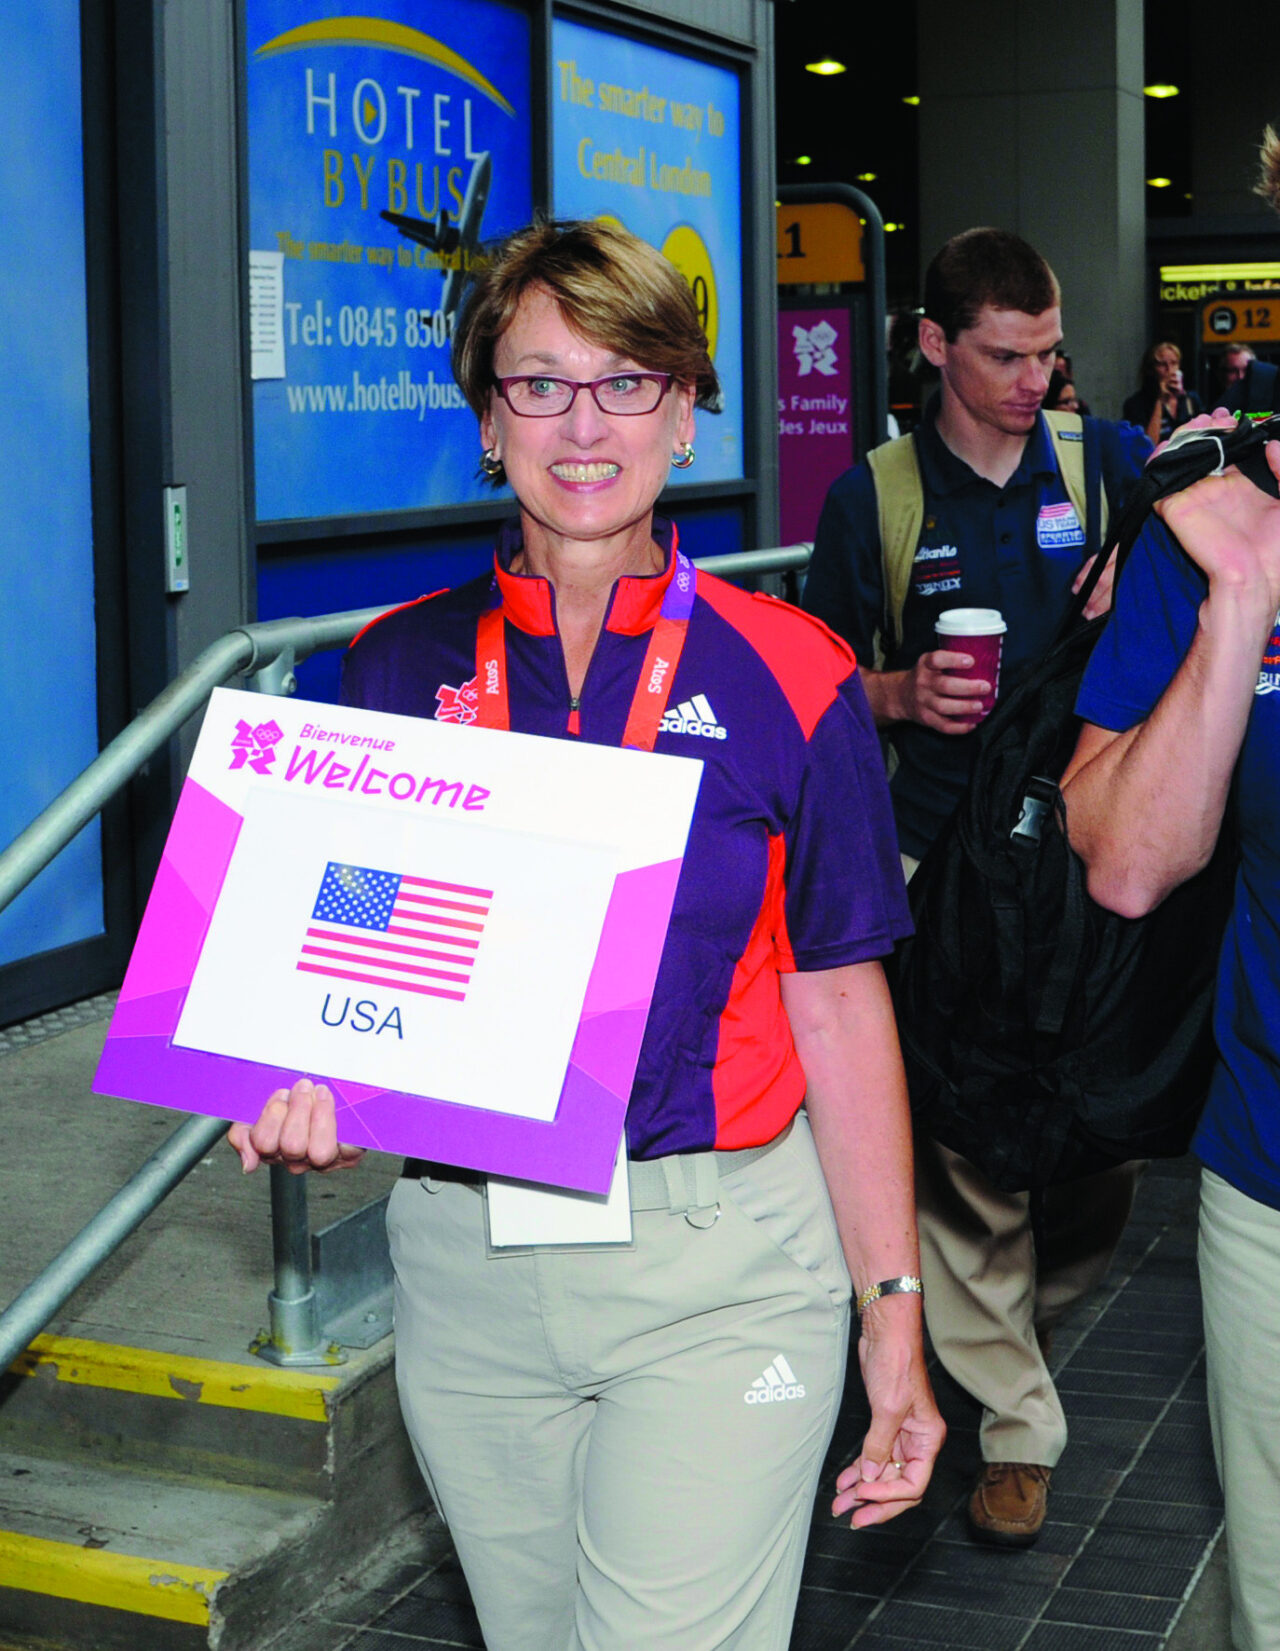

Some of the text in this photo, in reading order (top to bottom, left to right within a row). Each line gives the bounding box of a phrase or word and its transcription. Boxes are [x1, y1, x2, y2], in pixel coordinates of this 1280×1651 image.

[305, 67, 483, 161] HOTEL
[557, 60, 725, 143] The smarter way to
[323, 148, 464, 222] BY BUS
[577, 137, 712, 197] Central London
[275, 231, 305, 260] The
[308, 239, 363, 264] smarter
[366, 246, 395, 274] way
[398, 243, 413, 268] to
[414, 245, 461, 271] Central
[777, 222, 806, 258] 1
[285, 299, 333, 346] Tel:
[338, 305, 398, 347] 0845
[1243, 307, 1271, 329] 12
[791, 394, 847, 415] Family
[809, 419, 848, 435] Jeux
[299, 723, 395, 751] Bienvenue
[284, 745, 491, 811] Welcome
[321, 993, 403, 1040] USA
[743, 1384, 806, 1405] adidas
